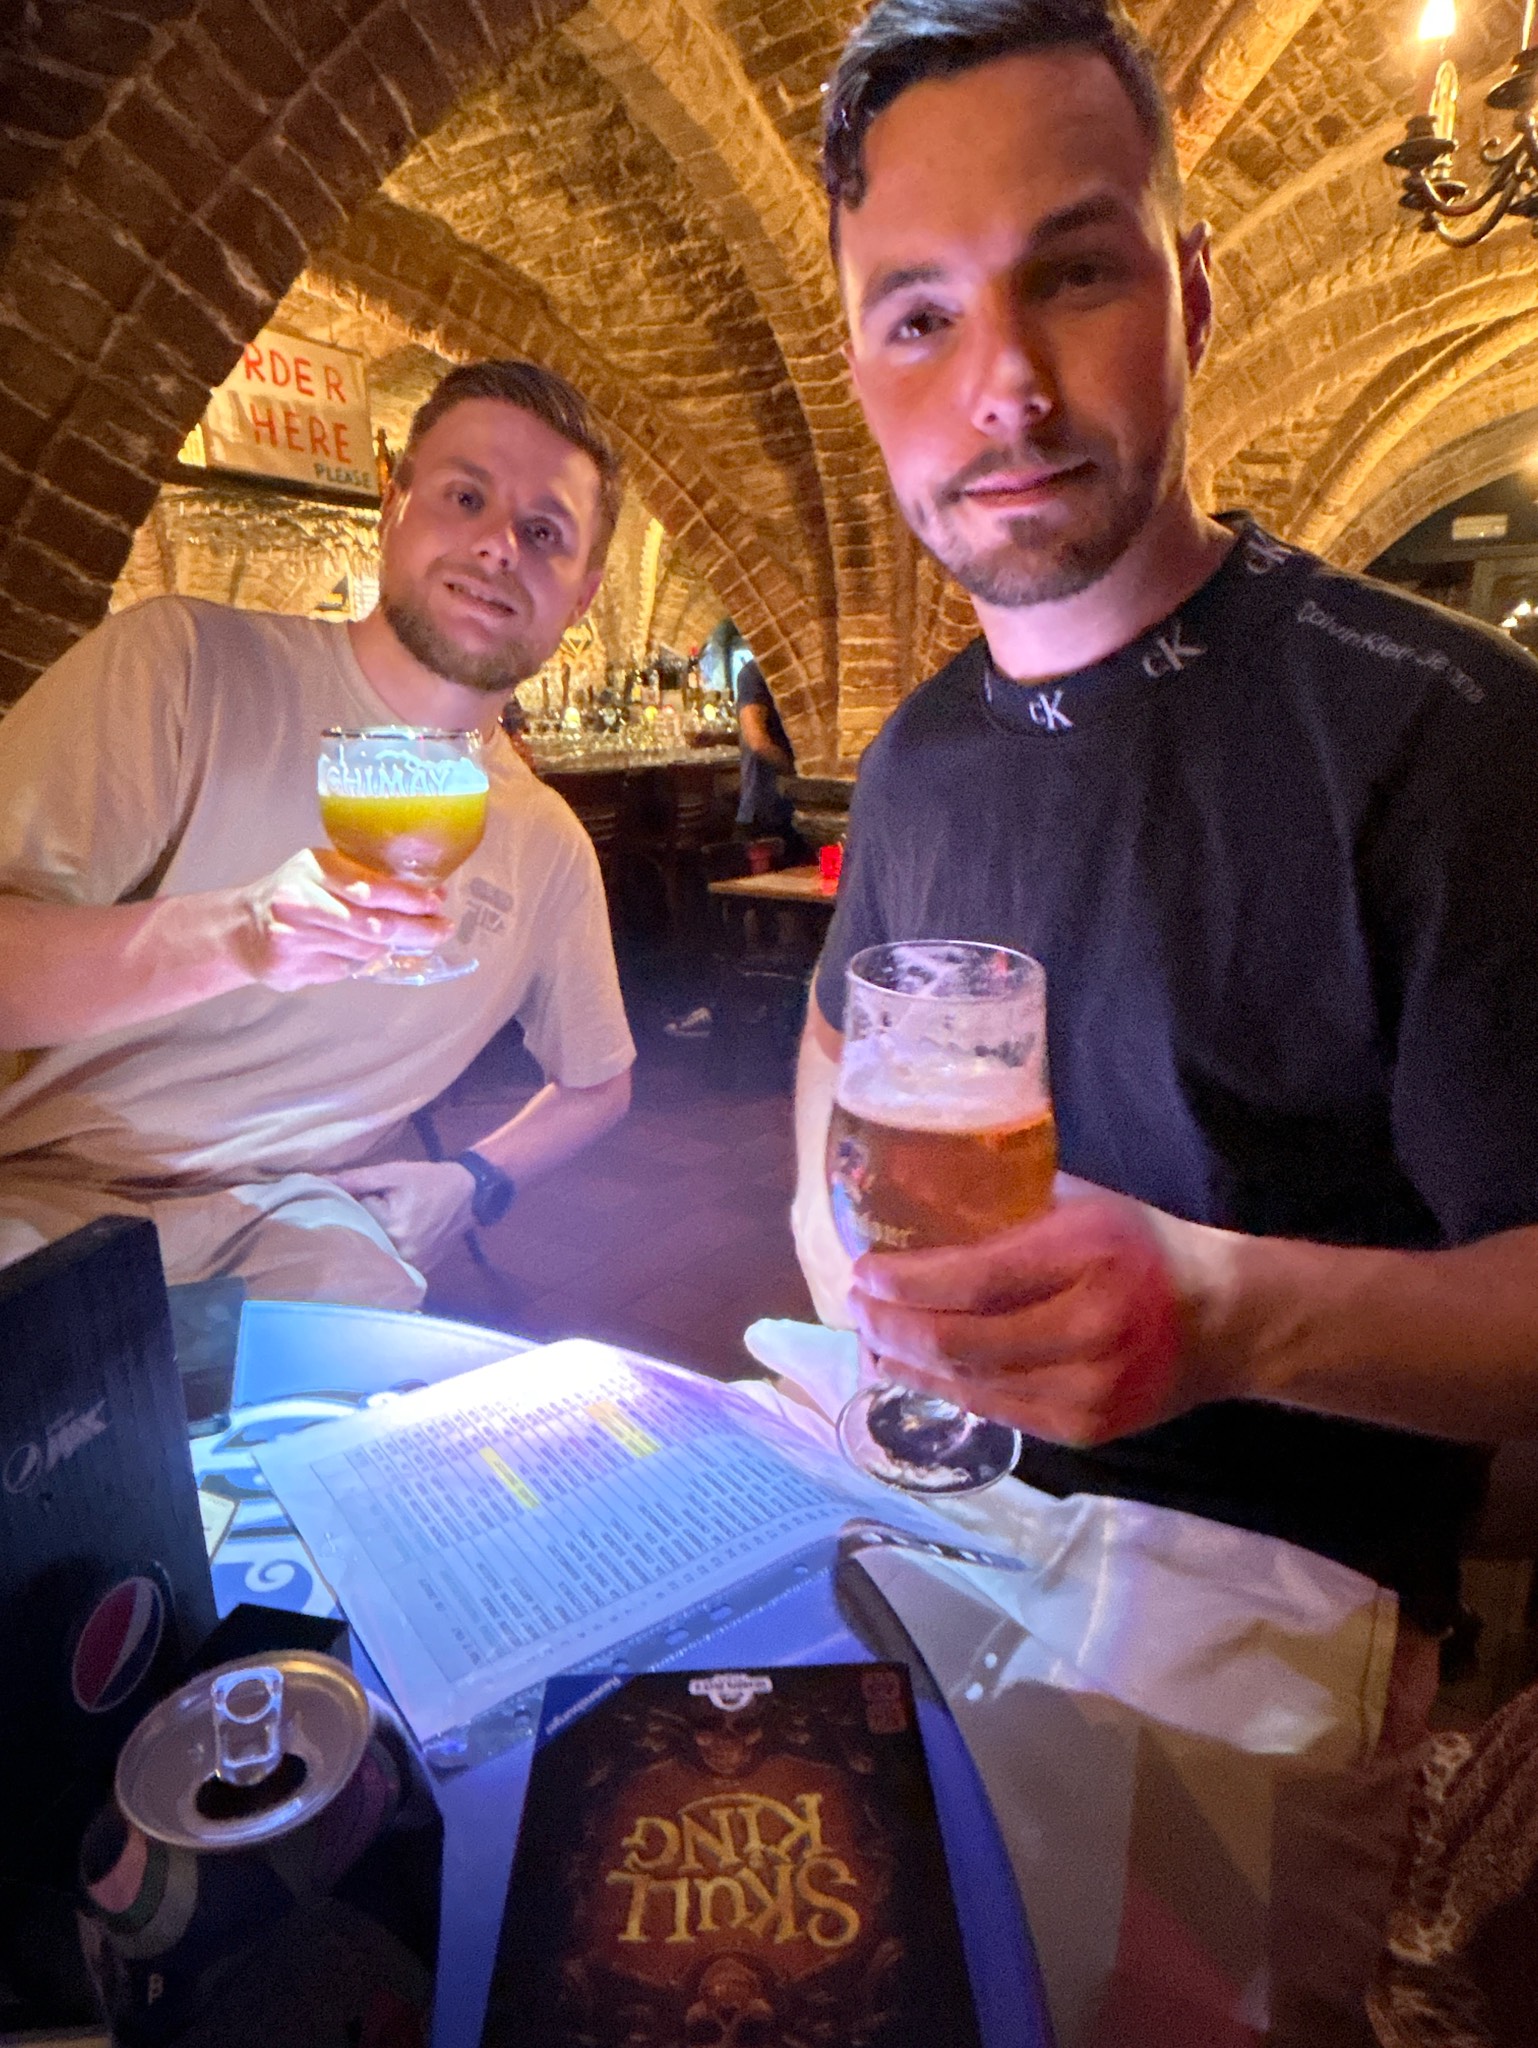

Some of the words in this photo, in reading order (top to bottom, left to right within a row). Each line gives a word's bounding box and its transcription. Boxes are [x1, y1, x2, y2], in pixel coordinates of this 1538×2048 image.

[243, 341, 347, 404] RDER
[250, 403, 352, 464] HERE
[313, 462, 371, 488] PLEASE
[326, 762, 450, 797] CHIMAY
